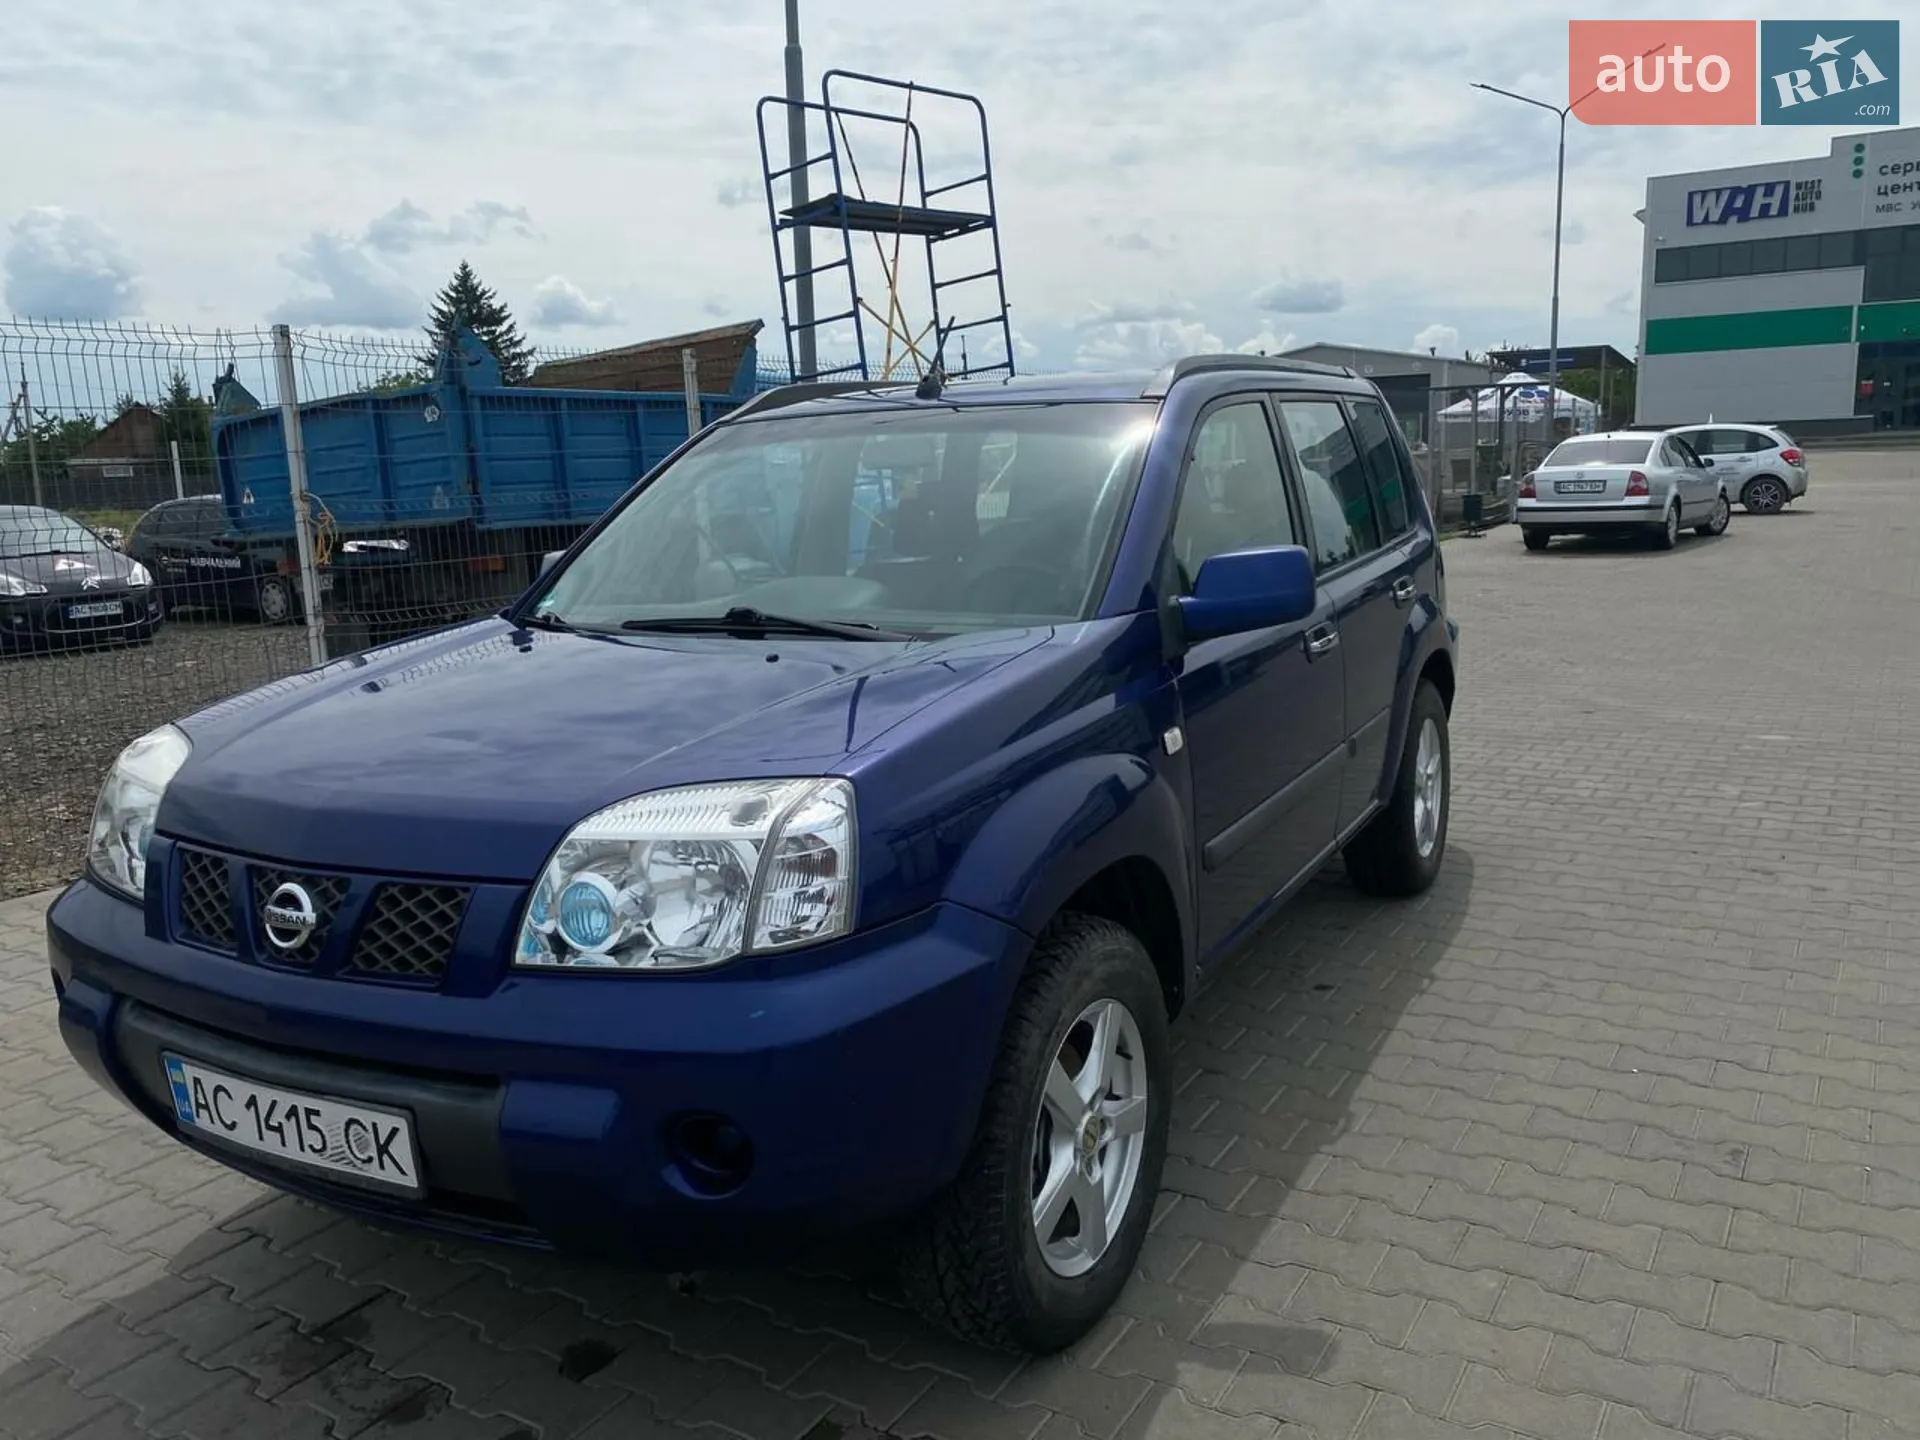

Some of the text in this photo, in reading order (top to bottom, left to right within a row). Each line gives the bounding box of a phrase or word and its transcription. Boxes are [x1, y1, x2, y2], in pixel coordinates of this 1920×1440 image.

[1795, 179, 1822, 191] WEST
[1794, 190, 1822, 202] AUTO
[1690, 182, 1786, 225] WAH
[1793, 201, 1815, 214] HUB
[193, 1076, 408, 1176] AC 1415 CK
